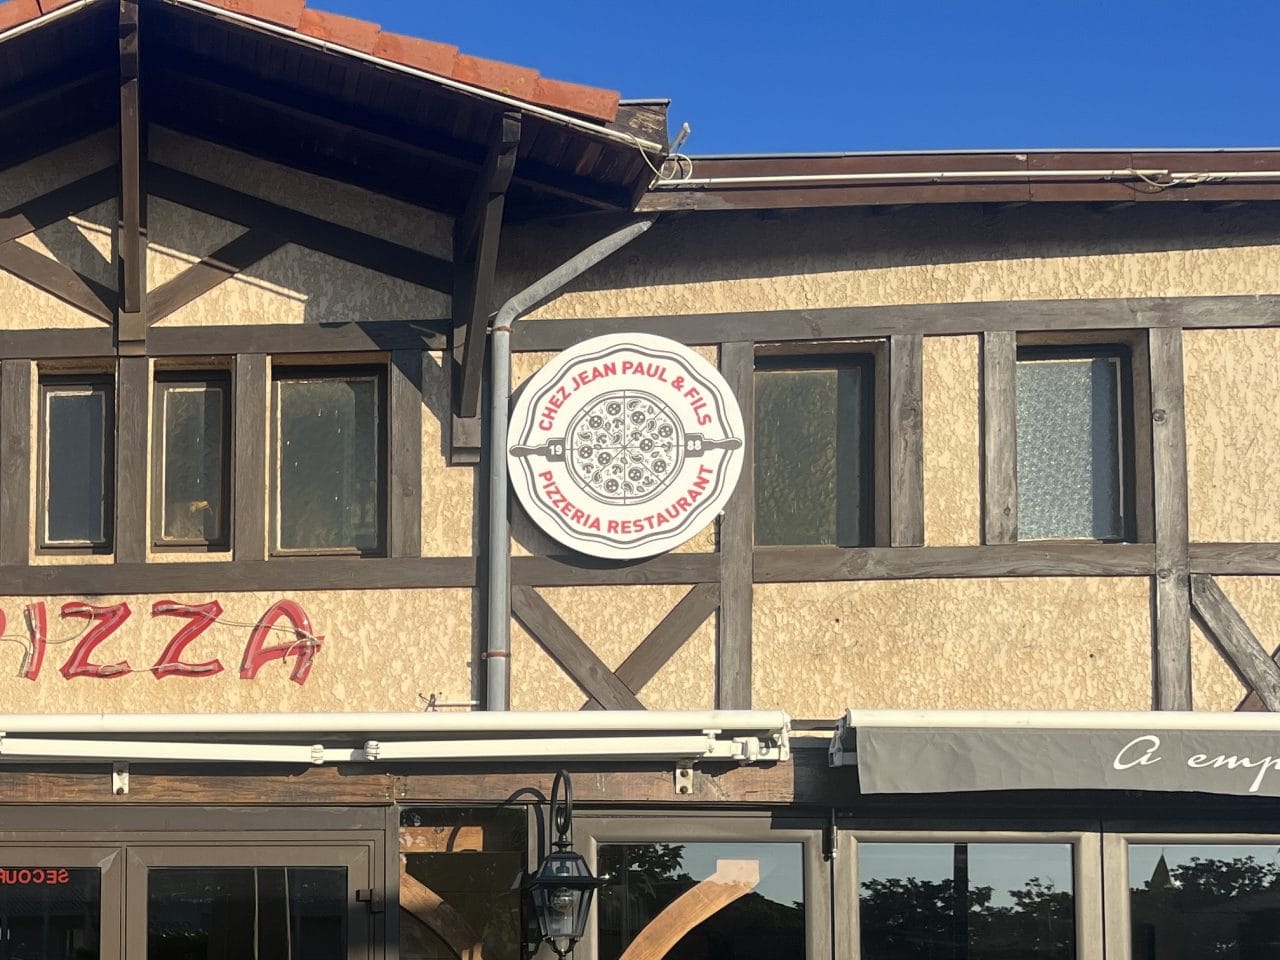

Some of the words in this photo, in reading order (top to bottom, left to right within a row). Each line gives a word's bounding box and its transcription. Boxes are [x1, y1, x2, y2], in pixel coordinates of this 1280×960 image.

[539, 386, 572, 431] CHEZ
[572, 362, 617, 392] JEAN
[622, 361, 668, 383] PAUL
[671, 375, 685, 391] &
[683, 387, 712, 426] FILS
[549, 444, 563, 456] 19
[687, 439, 703, 451] 88
[538, 470, 601, 532] PIZZERIA
[607, 464, 713, 534] RESTAURANT
[1113, 735, 1162, 770] A
